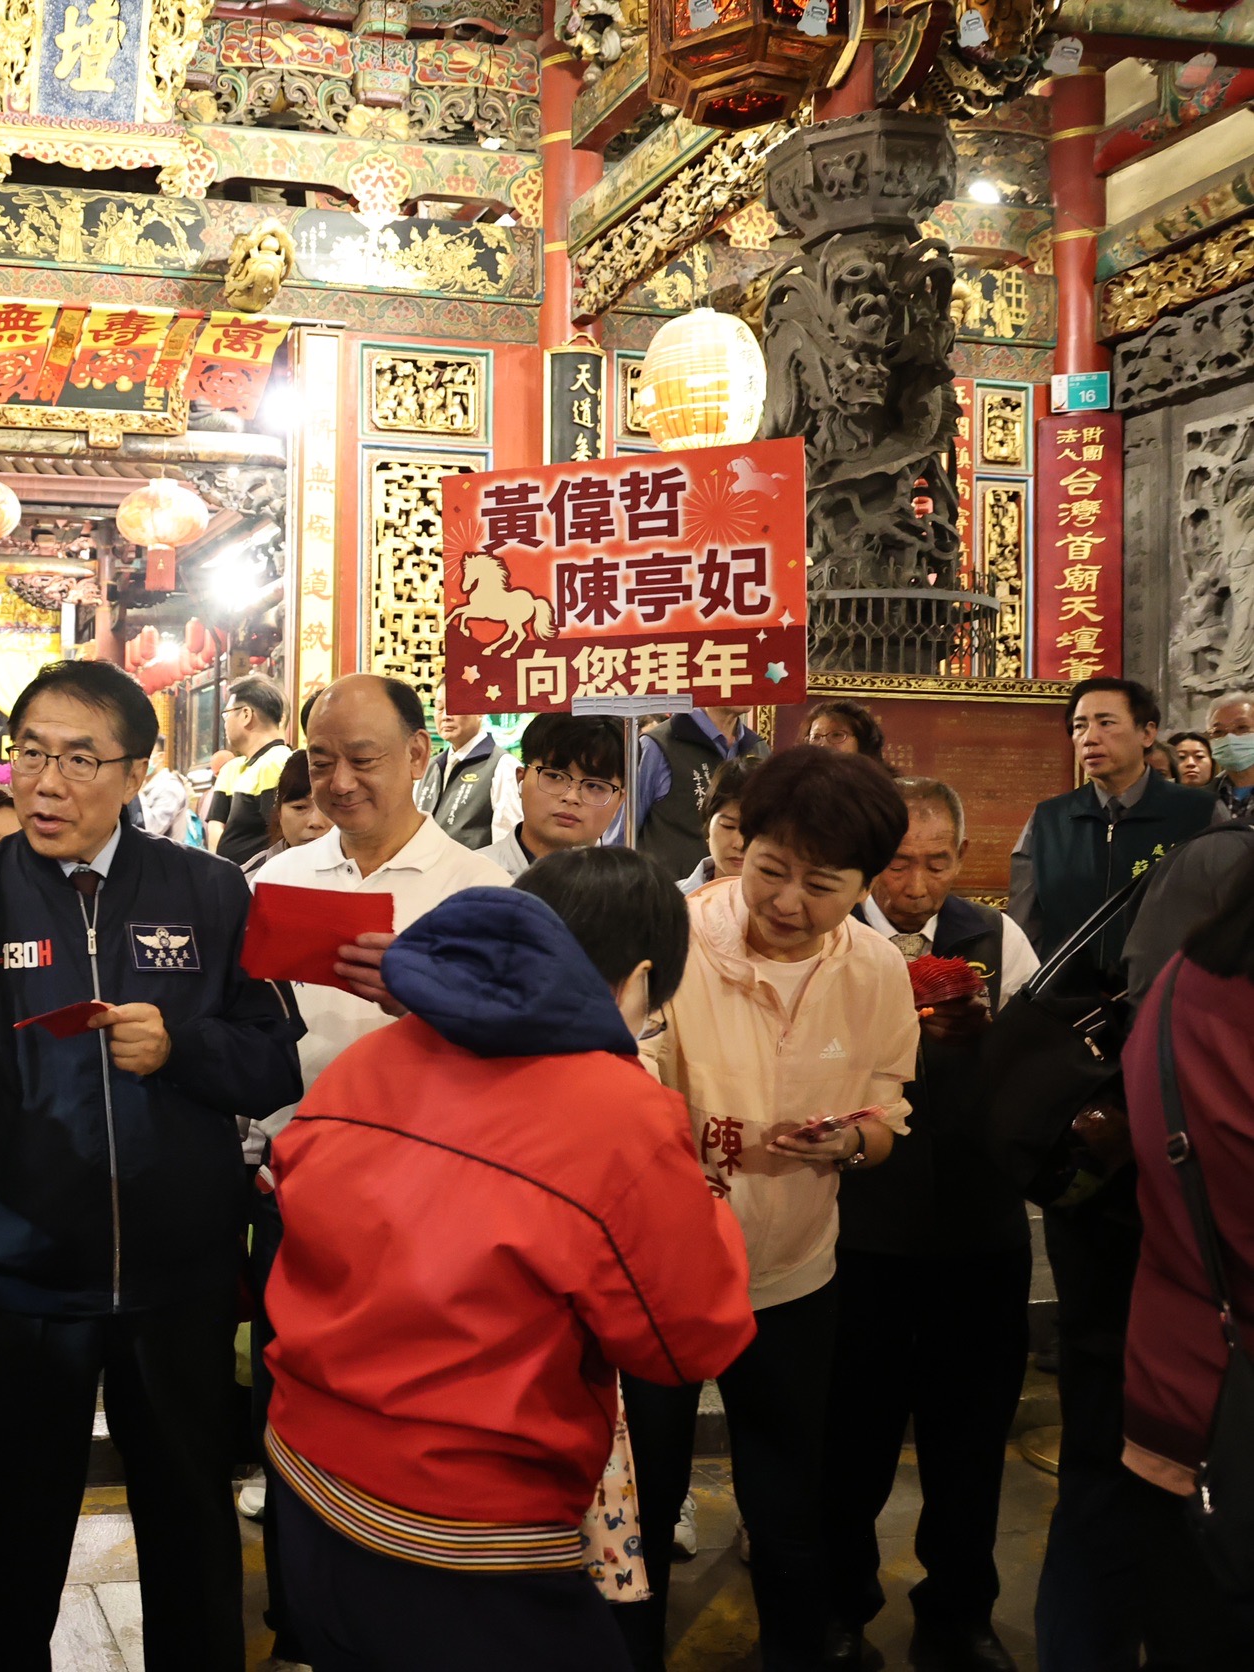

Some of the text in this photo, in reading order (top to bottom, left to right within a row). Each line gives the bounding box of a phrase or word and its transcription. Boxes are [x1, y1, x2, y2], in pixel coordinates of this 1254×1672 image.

[1079, 389, 1096, 403] 16
[481, 466, 687, 552] 黃偉哲
[555, 547, 772, 628] 陳亭妃
[517, 639, 753, 706] 向您拜年
